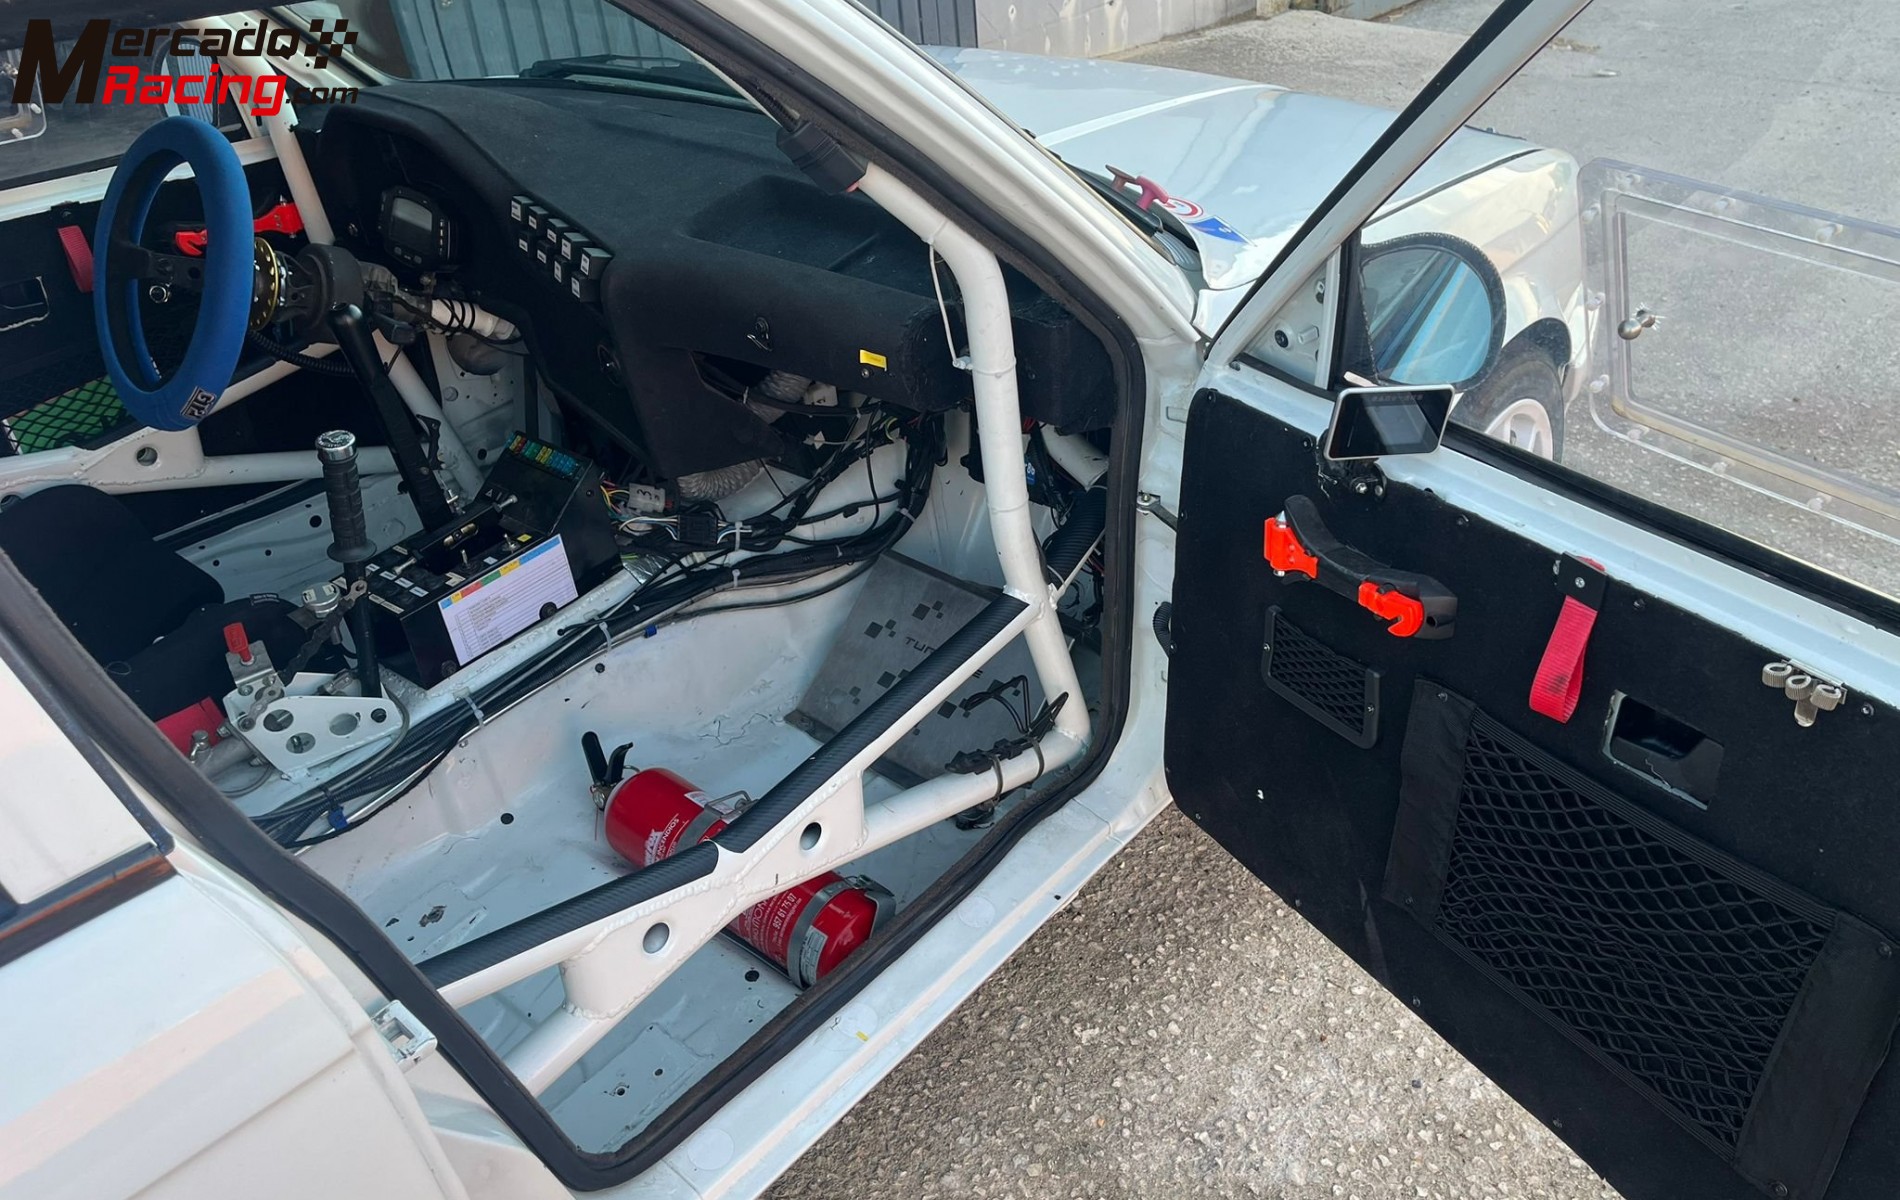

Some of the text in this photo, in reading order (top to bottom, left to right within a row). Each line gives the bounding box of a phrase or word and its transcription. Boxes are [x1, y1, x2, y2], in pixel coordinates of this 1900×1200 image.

[781, 900, 792, 909] 75
[777, 908, 787, 918] 61
[772, 915, 783, 930] 957
